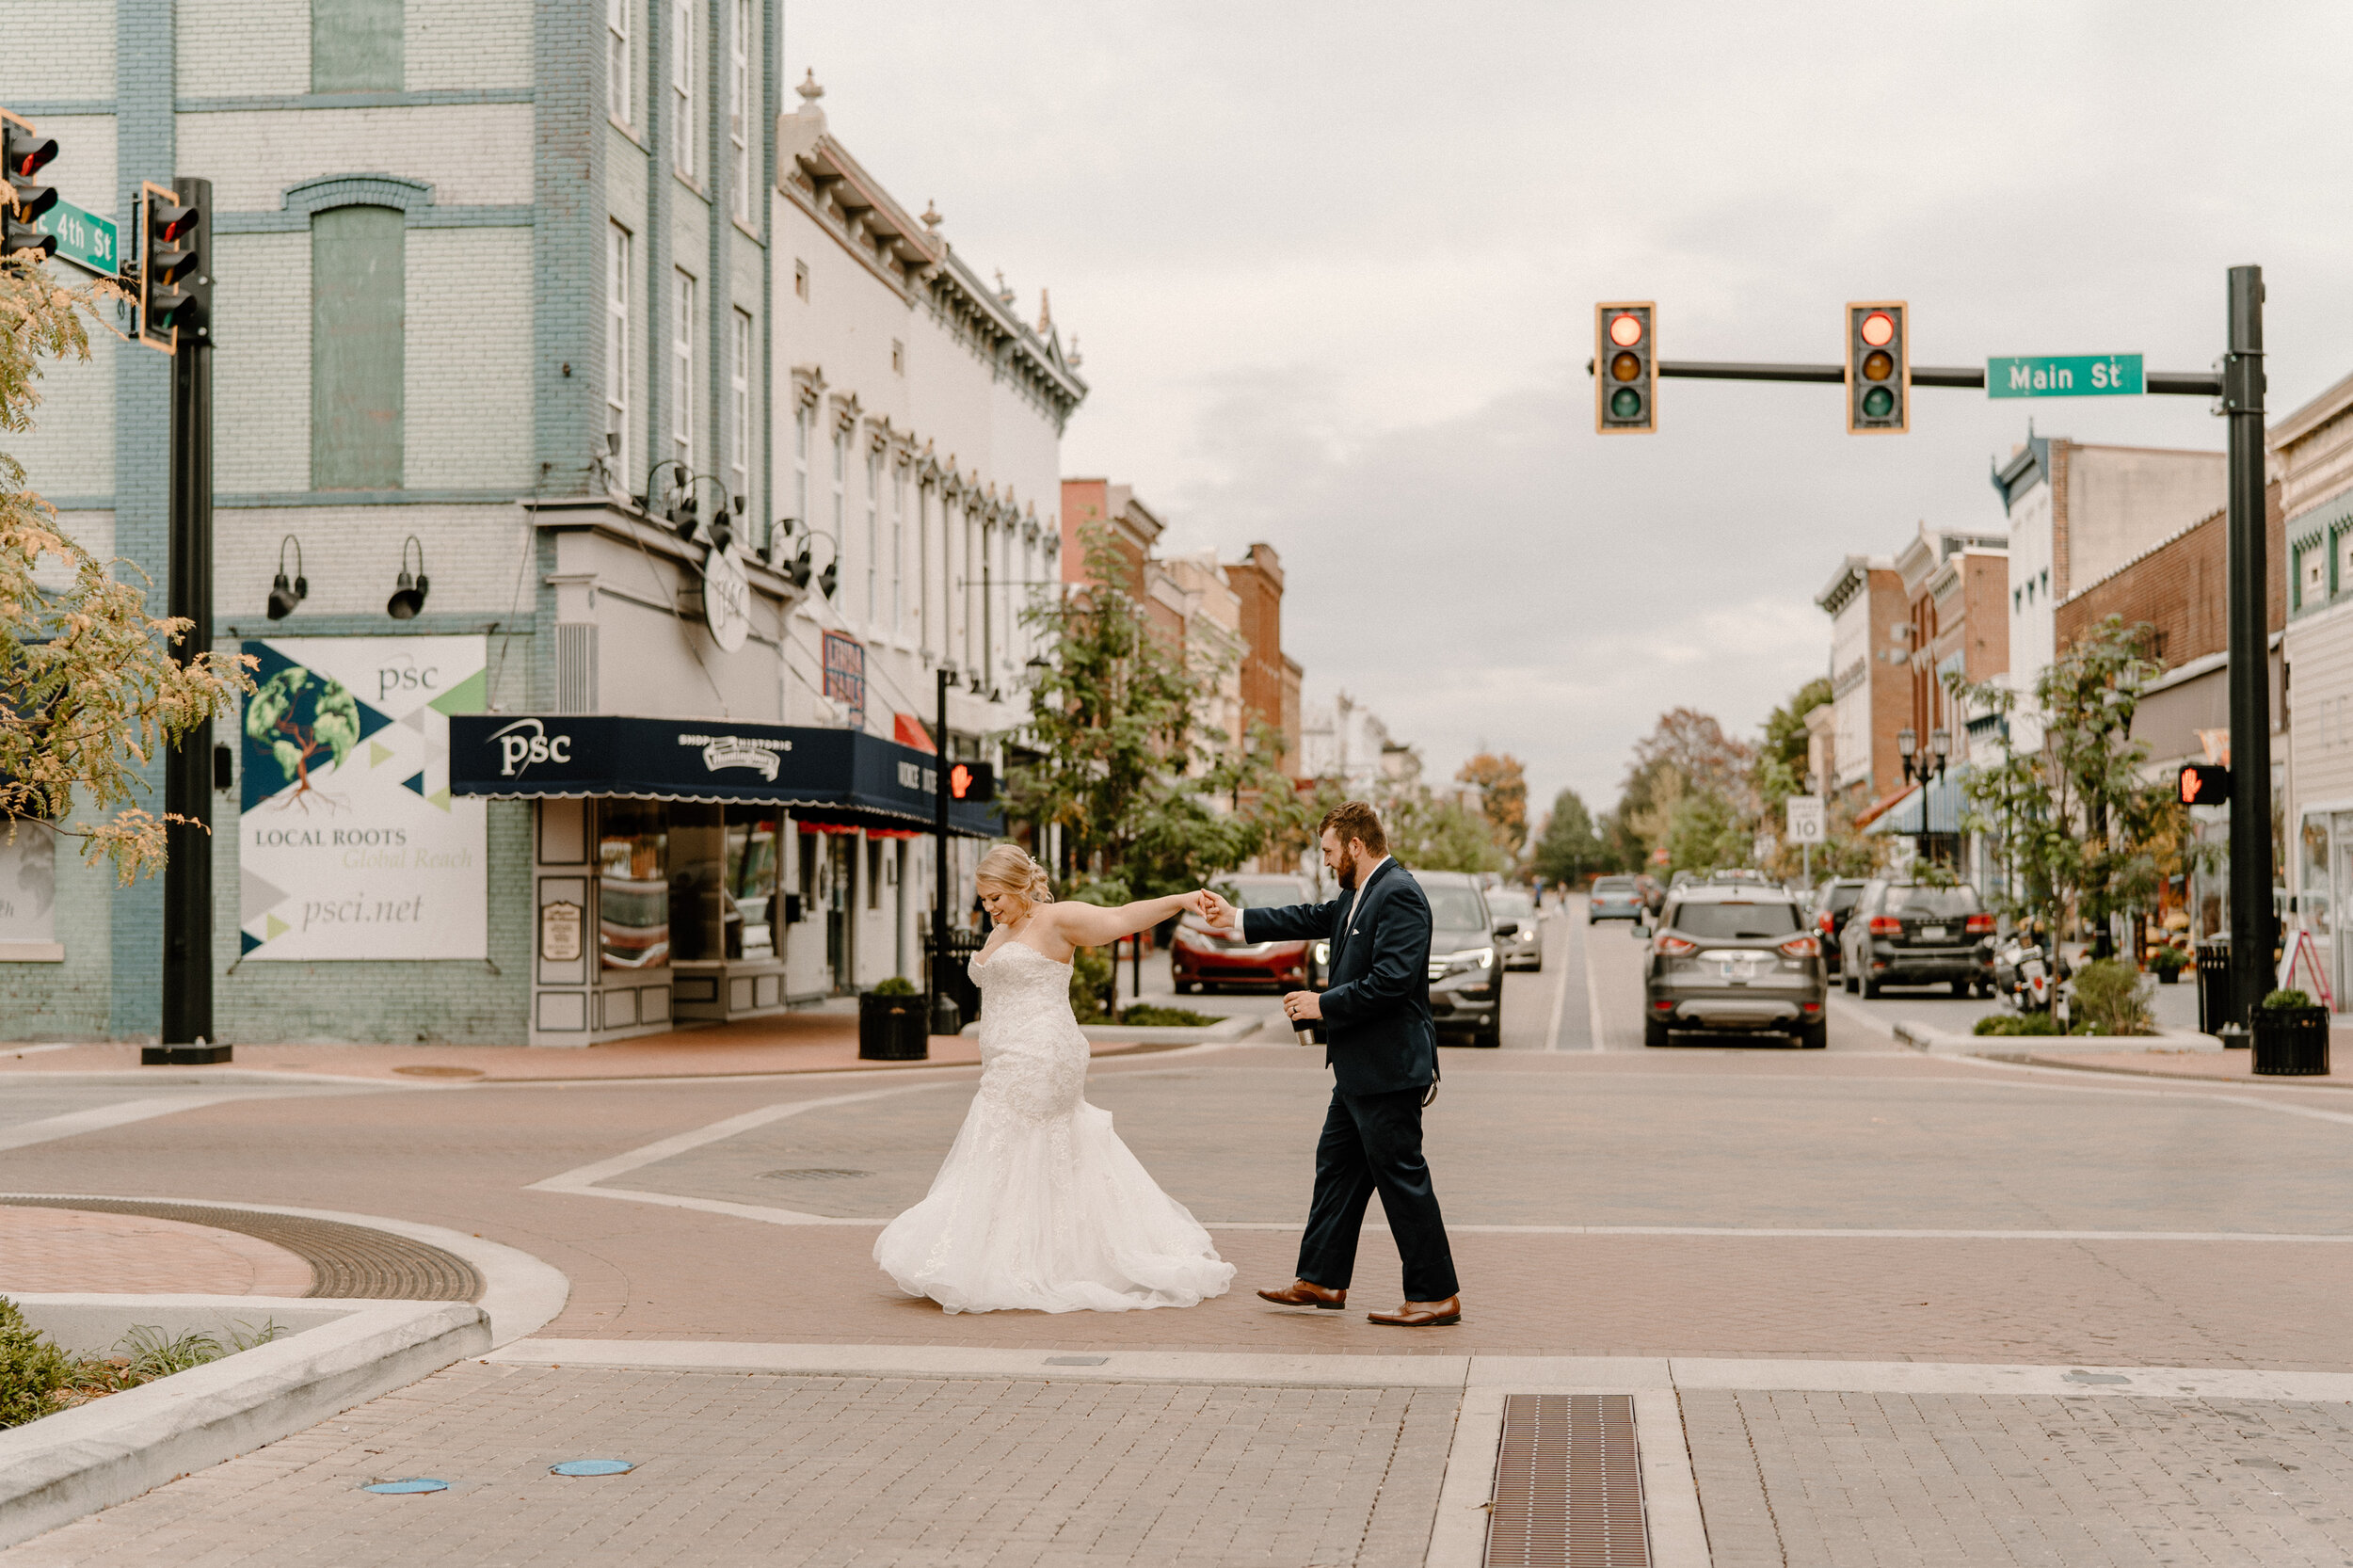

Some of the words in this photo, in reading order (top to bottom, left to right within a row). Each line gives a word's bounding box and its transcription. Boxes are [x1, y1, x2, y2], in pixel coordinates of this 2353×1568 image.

[57, 213, 85, 249] 4th
[94, 227, 113, 262] St
[2009, 363, 2073, 391] Main
[2091, 361, 2123, 389] St
[378, 666, 440, 703] psc
[500, 734, 572, 776] psc
[678, 734, 712, 747] SHOP
[738, 738, 792, 752] HISTORIC
[255, 828, 327, 846] LOCAL
[333, 827, 408, 845] ROOTS
[1796, 820, 1817, 837] 10
[343, 848, 408, 870] Global
[414, 847, 472, 869] Reach
[303, 892, 425, 933] psci.net
